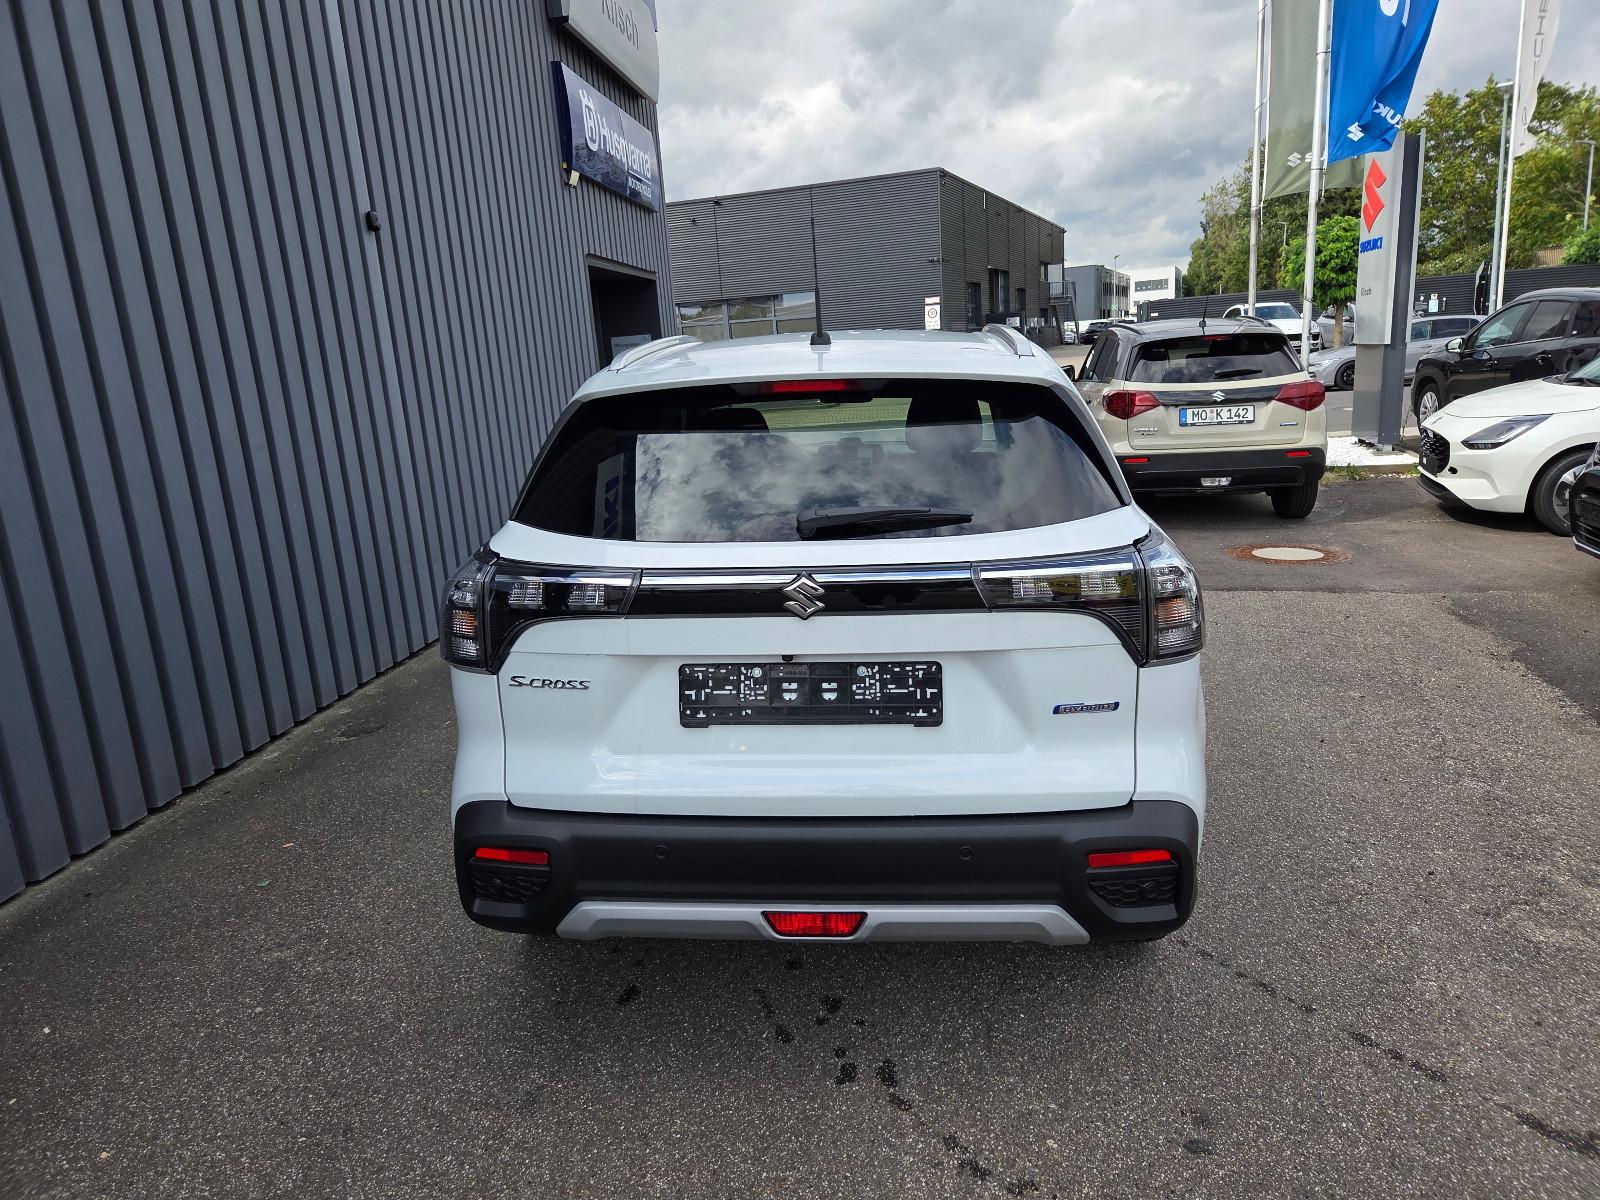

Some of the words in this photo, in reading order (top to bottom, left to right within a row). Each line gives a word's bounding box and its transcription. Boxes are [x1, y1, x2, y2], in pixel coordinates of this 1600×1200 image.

[597, 113, 652, 179] Husqvarna
[1360, 236, 1384, 254] SUZUKI
[1191, 409, 1208, 422] MO
[1215, 408, 1225, 420] K
[1226, 407, 1249, 420] 142
[508, 675, 591, 690] S-CROSS
